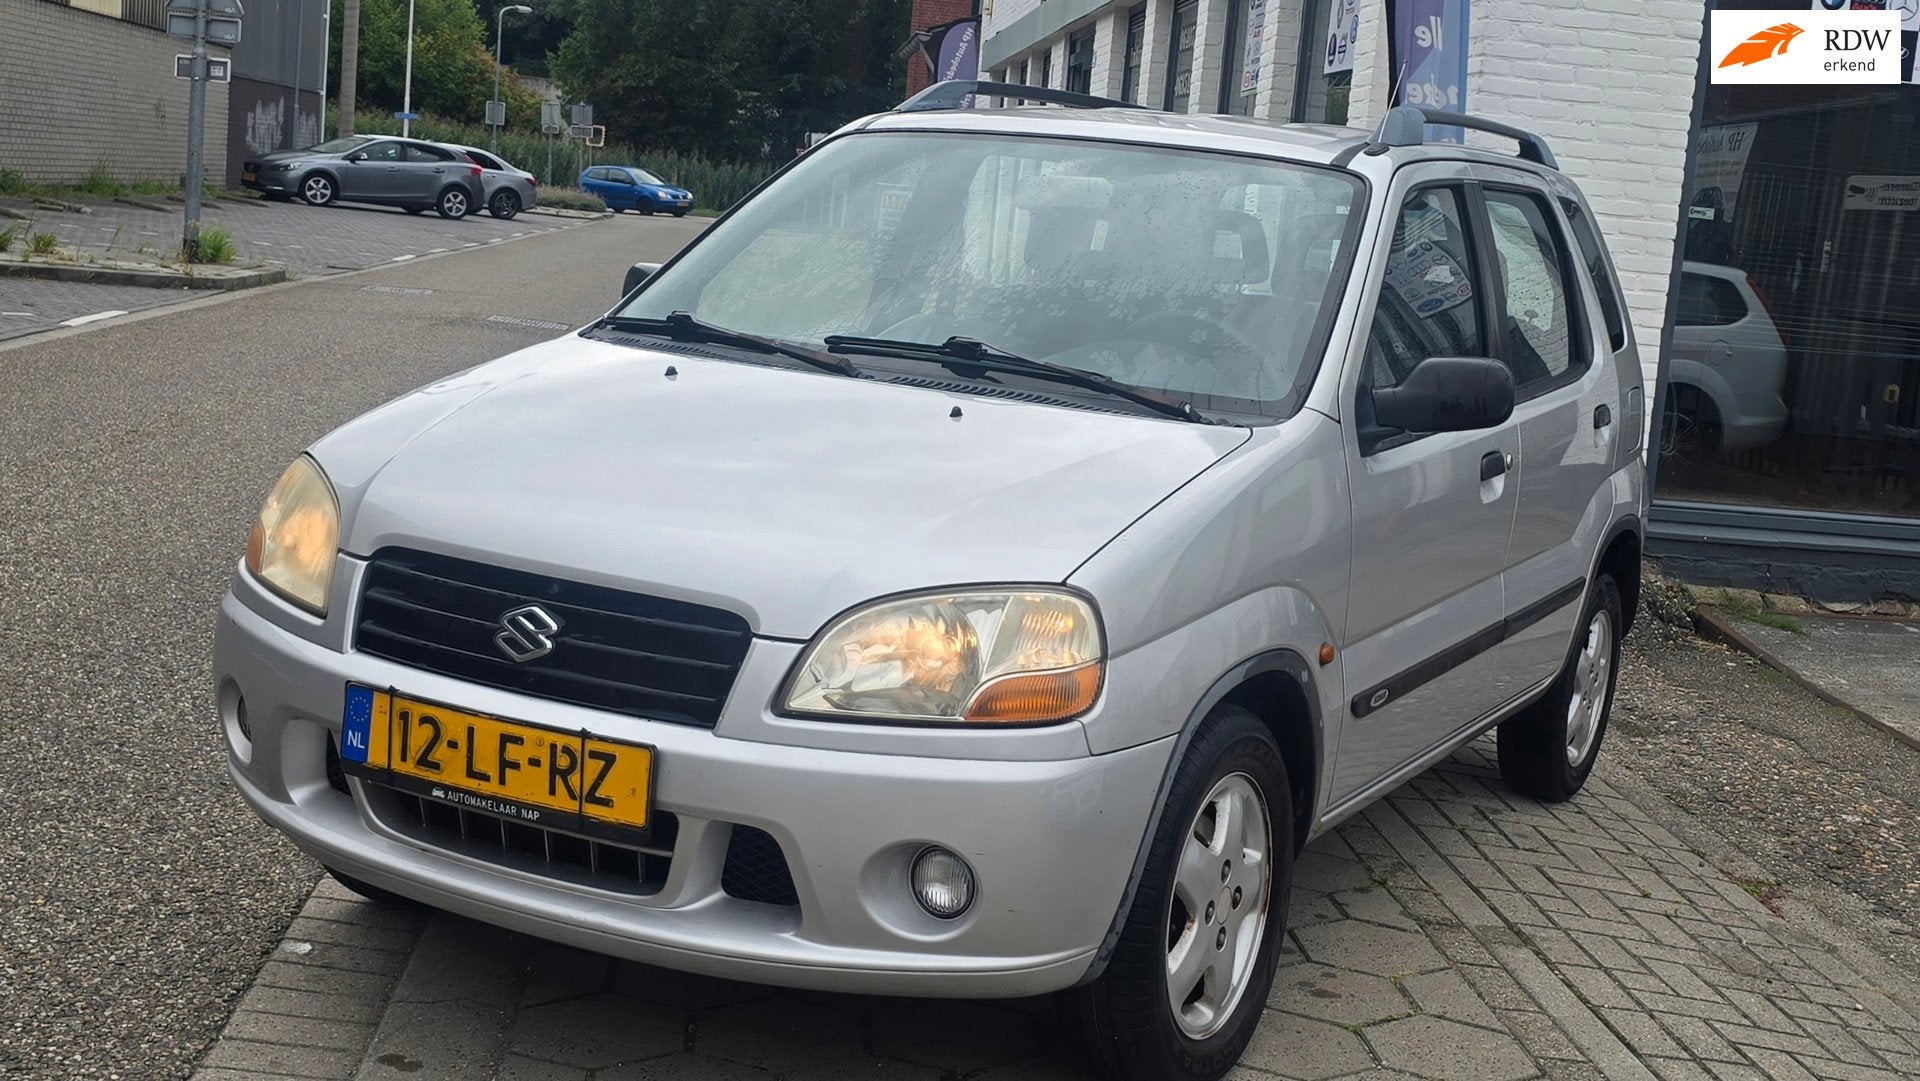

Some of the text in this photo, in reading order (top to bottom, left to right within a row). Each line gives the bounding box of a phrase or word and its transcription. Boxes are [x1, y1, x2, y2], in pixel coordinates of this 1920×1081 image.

[347, 729, 365, 749] NL
[398, 710, 617, 808] 12-LF-RZ
[447, 791, 540, 821] AUTOMAKELAAR NAP
